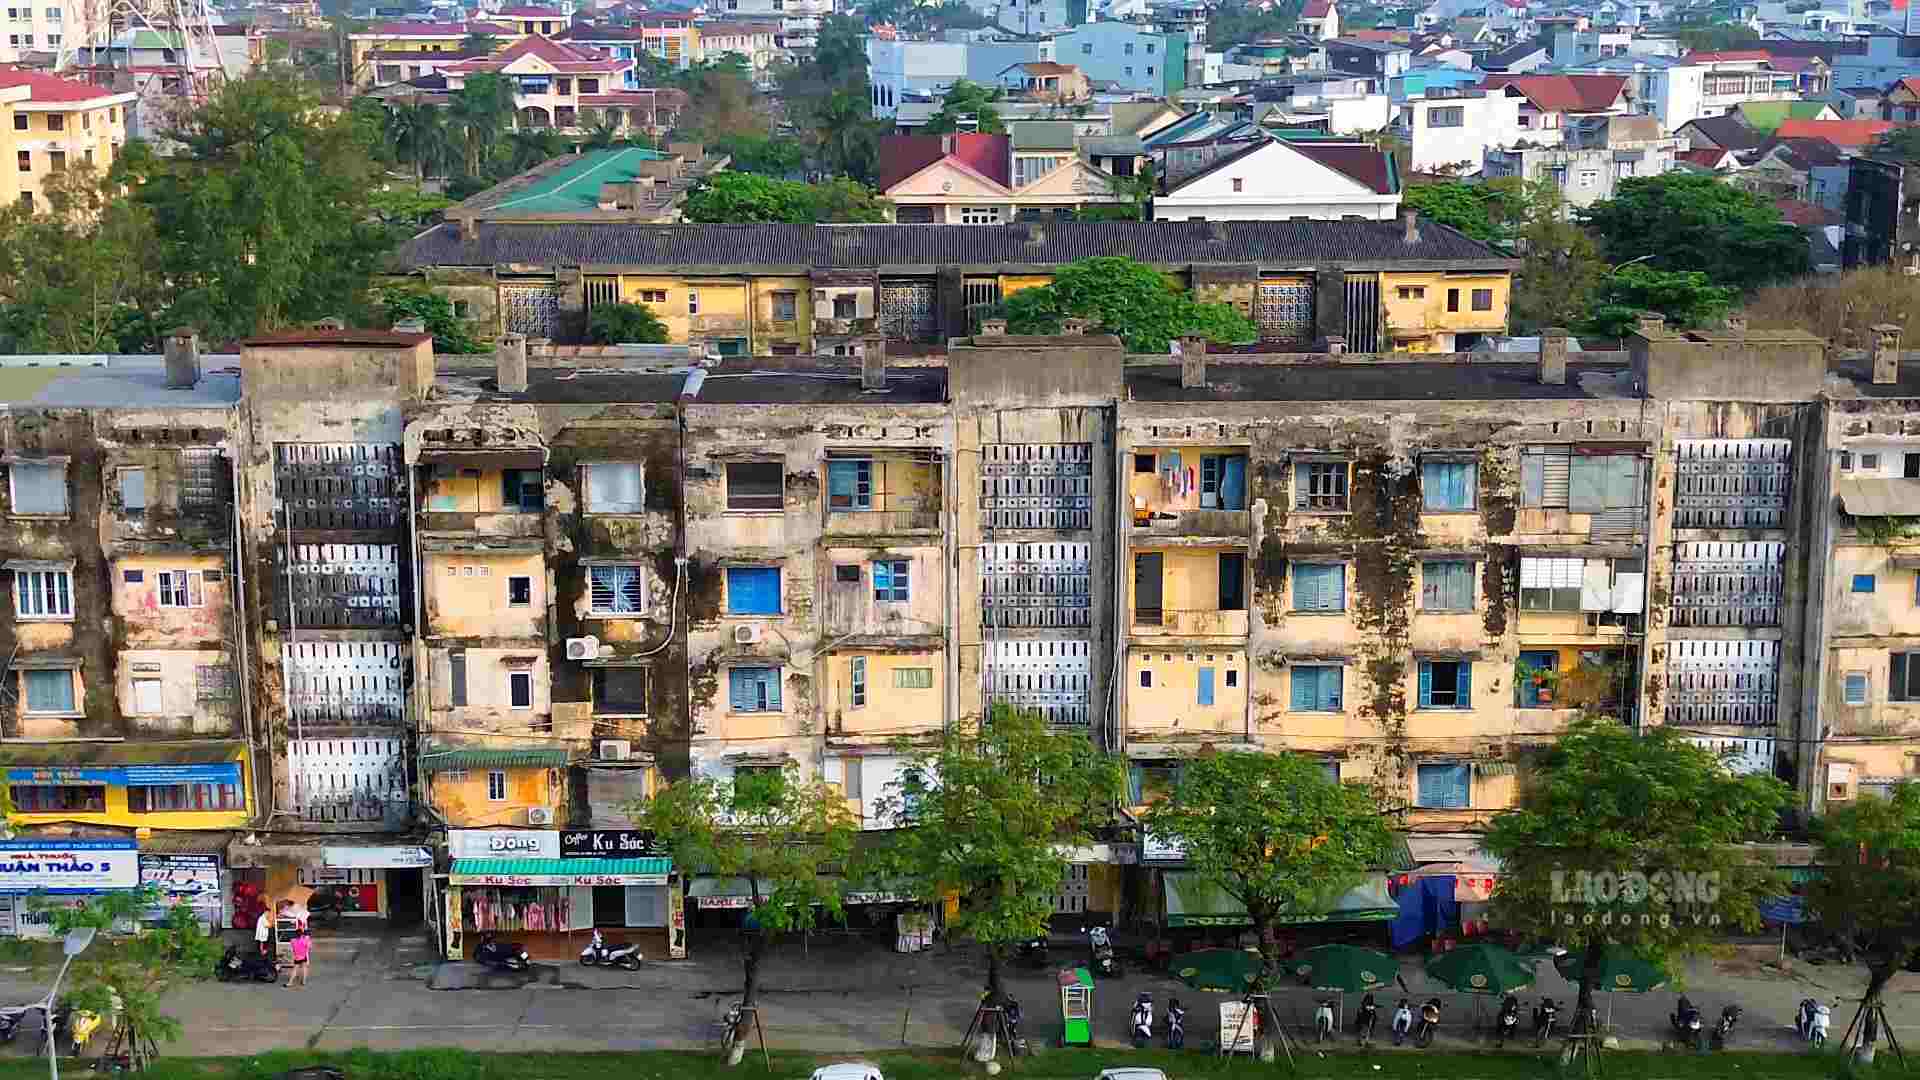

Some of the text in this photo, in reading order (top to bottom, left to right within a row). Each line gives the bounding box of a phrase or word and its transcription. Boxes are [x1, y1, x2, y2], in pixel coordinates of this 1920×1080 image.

[593, 833, 613, 850] Ku
[100, 862, 111, 872] 5
[485, 876, 503, 884] Ku
[576, 876, 592, 884] Ku
